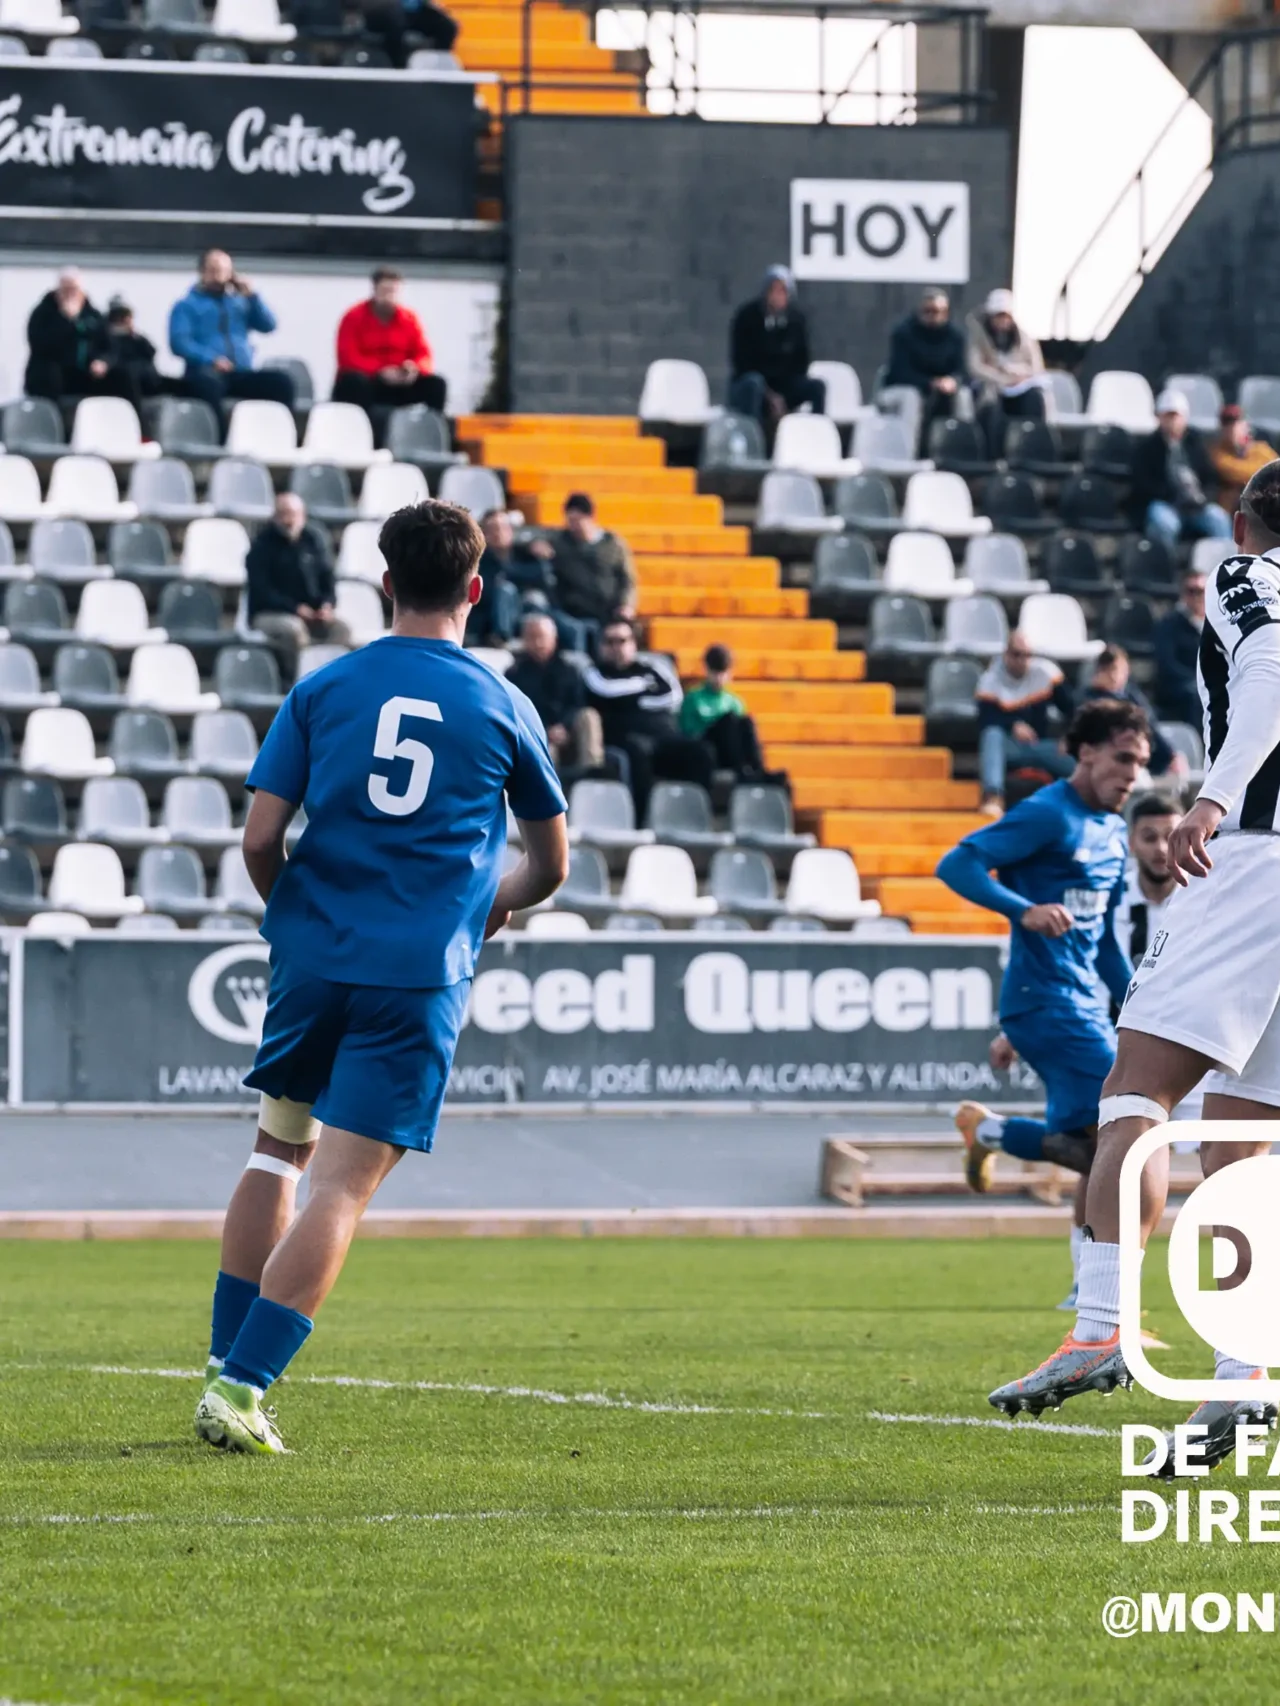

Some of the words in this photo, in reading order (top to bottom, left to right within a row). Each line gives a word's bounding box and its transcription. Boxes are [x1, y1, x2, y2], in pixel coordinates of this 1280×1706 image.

[226, 107, 415, 213] Catering
[802, 203, 955, 259] HOY
[367, 695, 444, 817] 5
[464, 954, 656, 1034] eed
[684, 951, 992, 1035] Queen
[158, 1065, 262, 1095] LAVAN
[744, 1062, 864, 1093] ALCARAZ
[865, 1062, 888, 1091] Y
